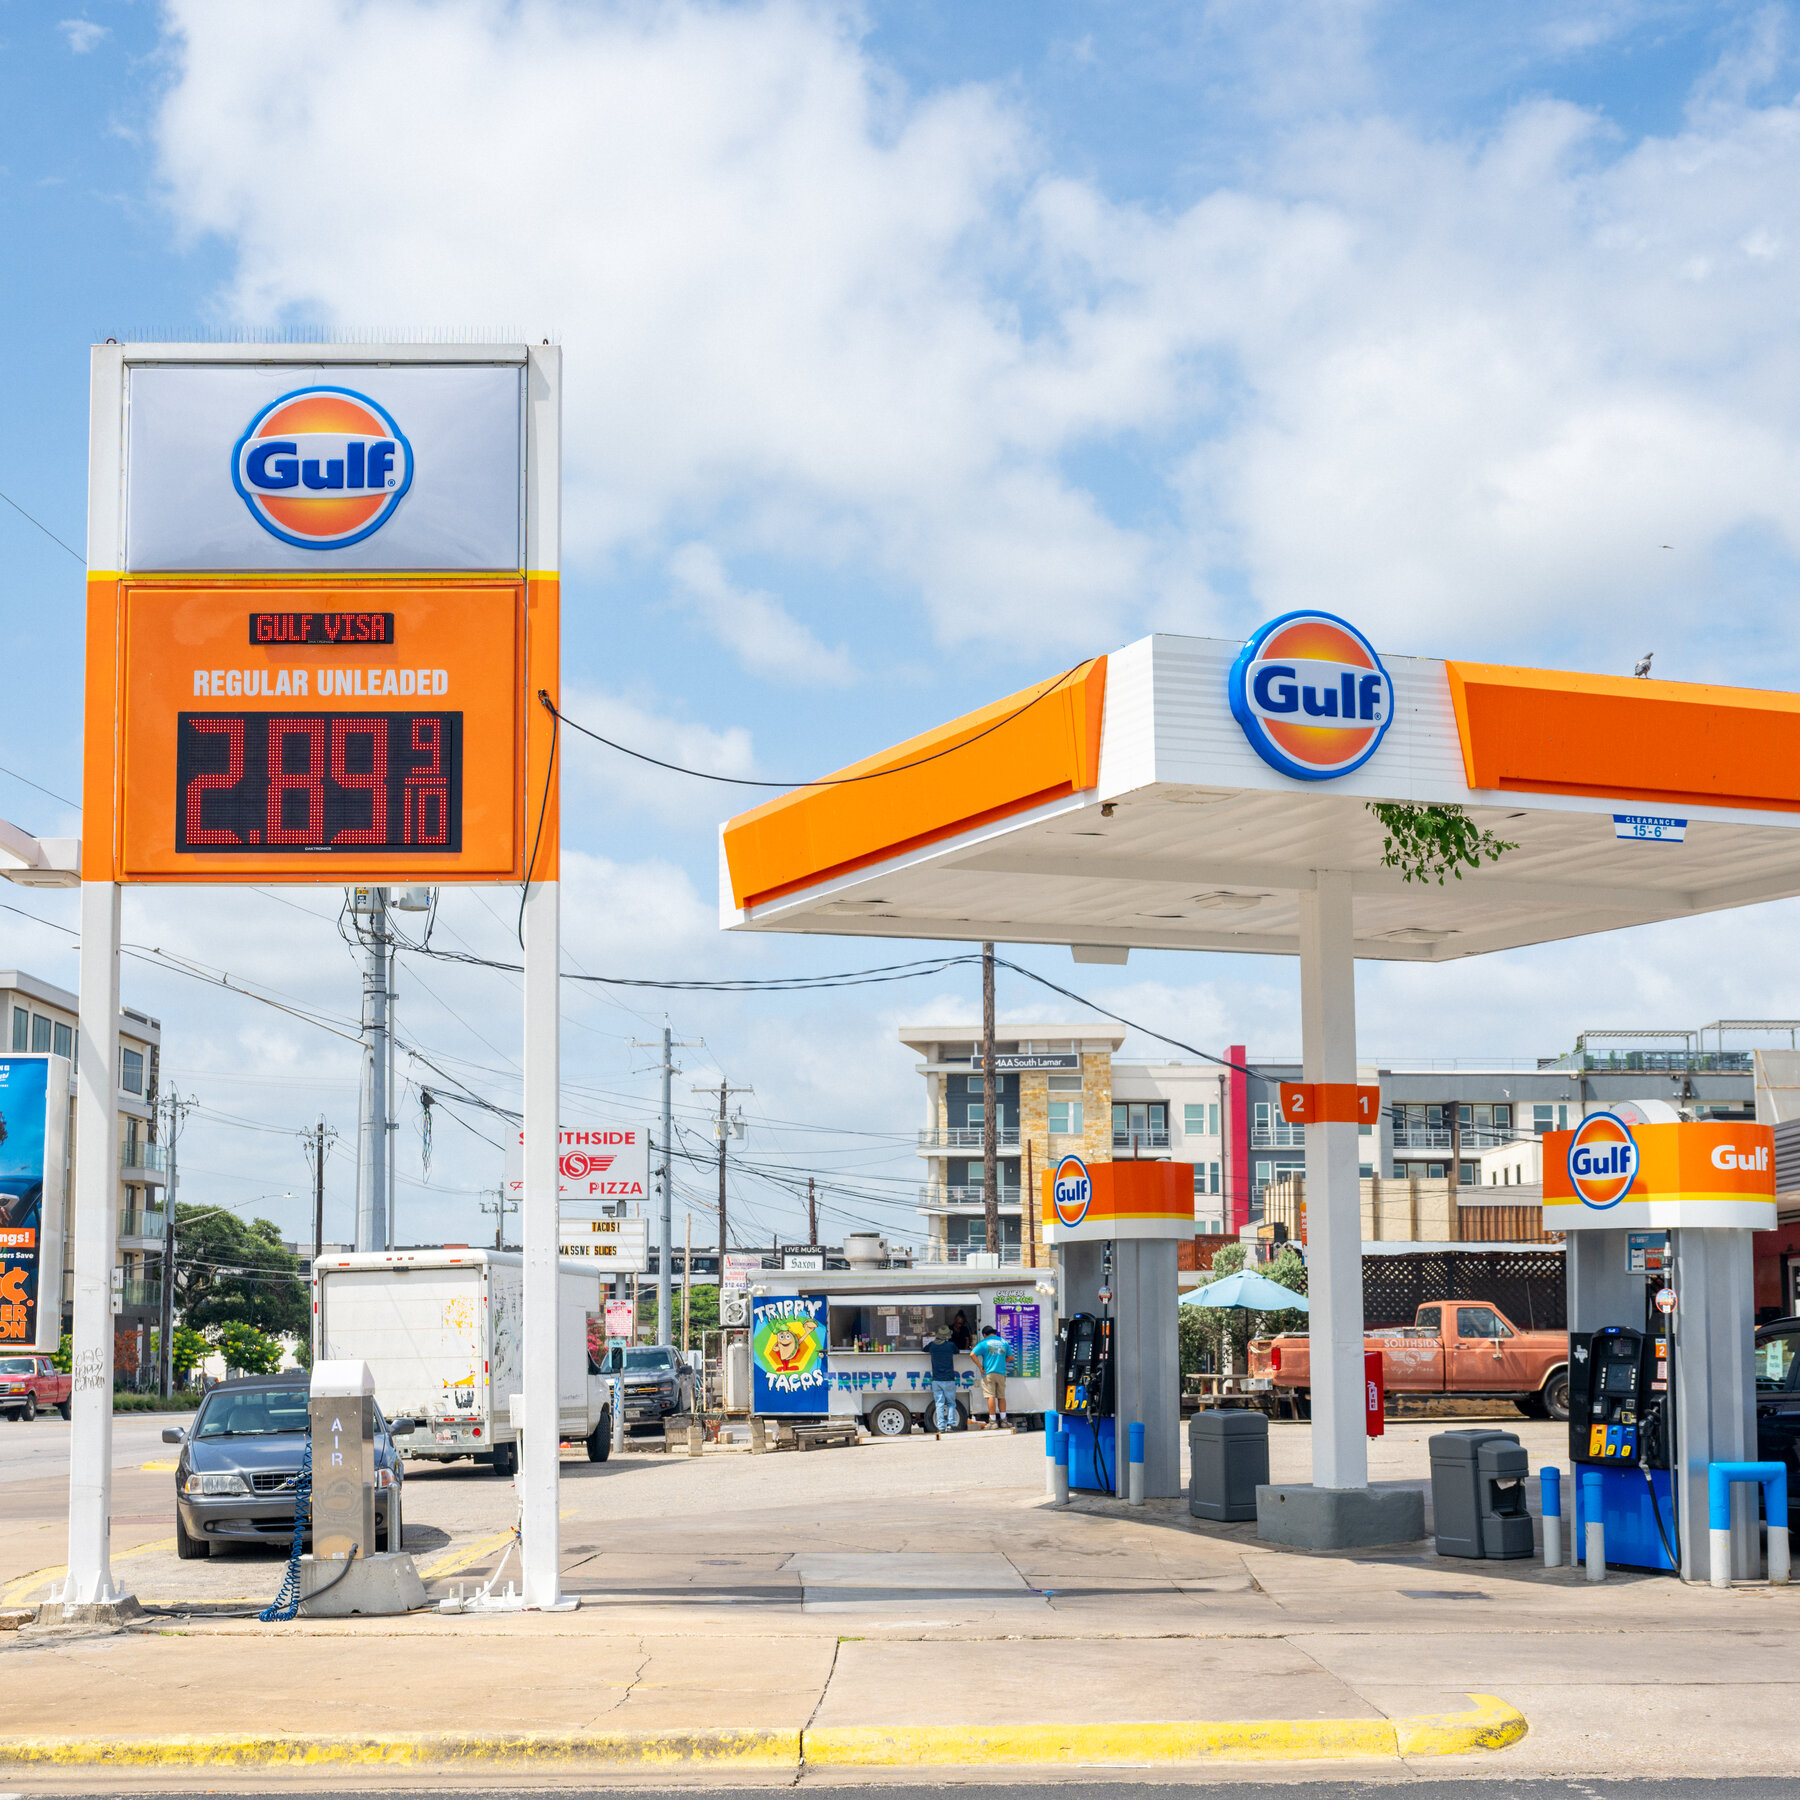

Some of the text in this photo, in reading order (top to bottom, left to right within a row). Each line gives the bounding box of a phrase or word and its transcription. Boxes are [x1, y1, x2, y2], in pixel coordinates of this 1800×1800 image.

[247, 441, 395, 489] Gulf
[257, 614, 385, 641] GULF VISA
[194, 669, 448, 696] REGULAR UNLEADED
[1253, 665, 1382, 720] Gulf
[186, 718, 440, 844] 2.89 9
[404, 788, 447, 844] 10
[1625, 817, 1676, 826] CLEARANCE
[1013, 1058, 1037, 1067] South
[1038, 1057, 1062, 1066] Lamar
[1291, 1094, 1304, 1112] 2
[1359, 1096, 1368, 1114] 1
[519, 1132, 635, 1145] THSIDE
[1573, 1146, 1631, 1175] Gulf
[1711, 1145, 1768, 1171] Gulf
[589, 1182, 642, 1194] PIZZA
[1056, 1180, 1087, 1202] Gulf
[594, 1246, 616, 1255] SLICES
[791, 1257, 816, 1269] Saxon
[753, 1299, 823, 1323] TRIPPY
[1384, 1339, 1438, 1348] SOUTHSIDE
[1659, 1345, 1665, 1356] 2
[766, 1369, 824, 1394] TACOS
[824, 1370, 976, 1394] TRIPPY TAS
[331, 1417, 343, 1467] AIR
